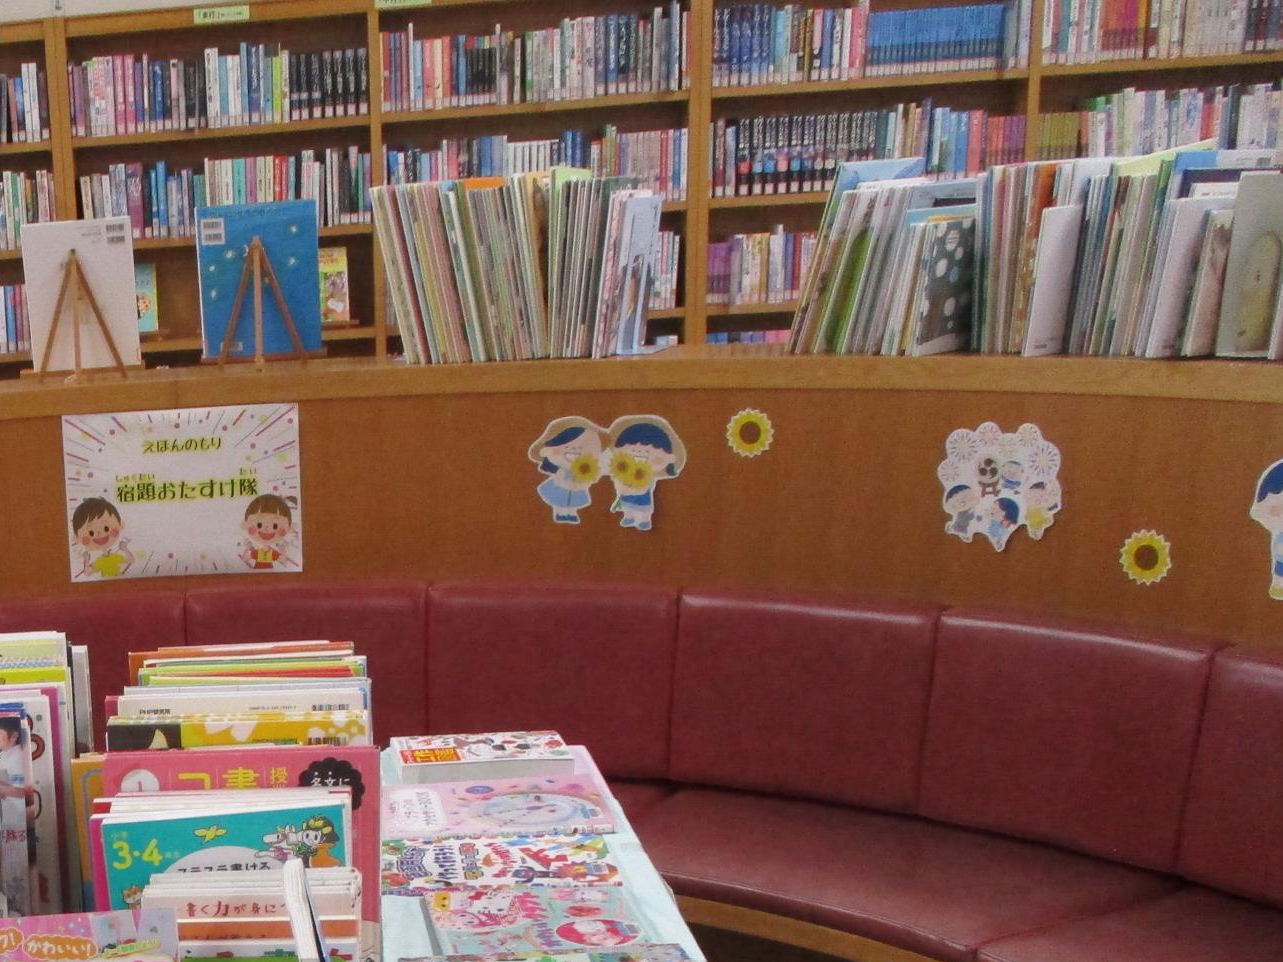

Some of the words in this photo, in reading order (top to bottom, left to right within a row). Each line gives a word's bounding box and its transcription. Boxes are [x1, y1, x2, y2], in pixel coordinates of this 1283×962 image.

[142, 436, 223, 453] えほんのもり
[117, 477, 258, 503] 宿題おたすけ隊
[186, 900, 287, 919] 書く力が身に
[26, 938, 93, 958] かわいい!
